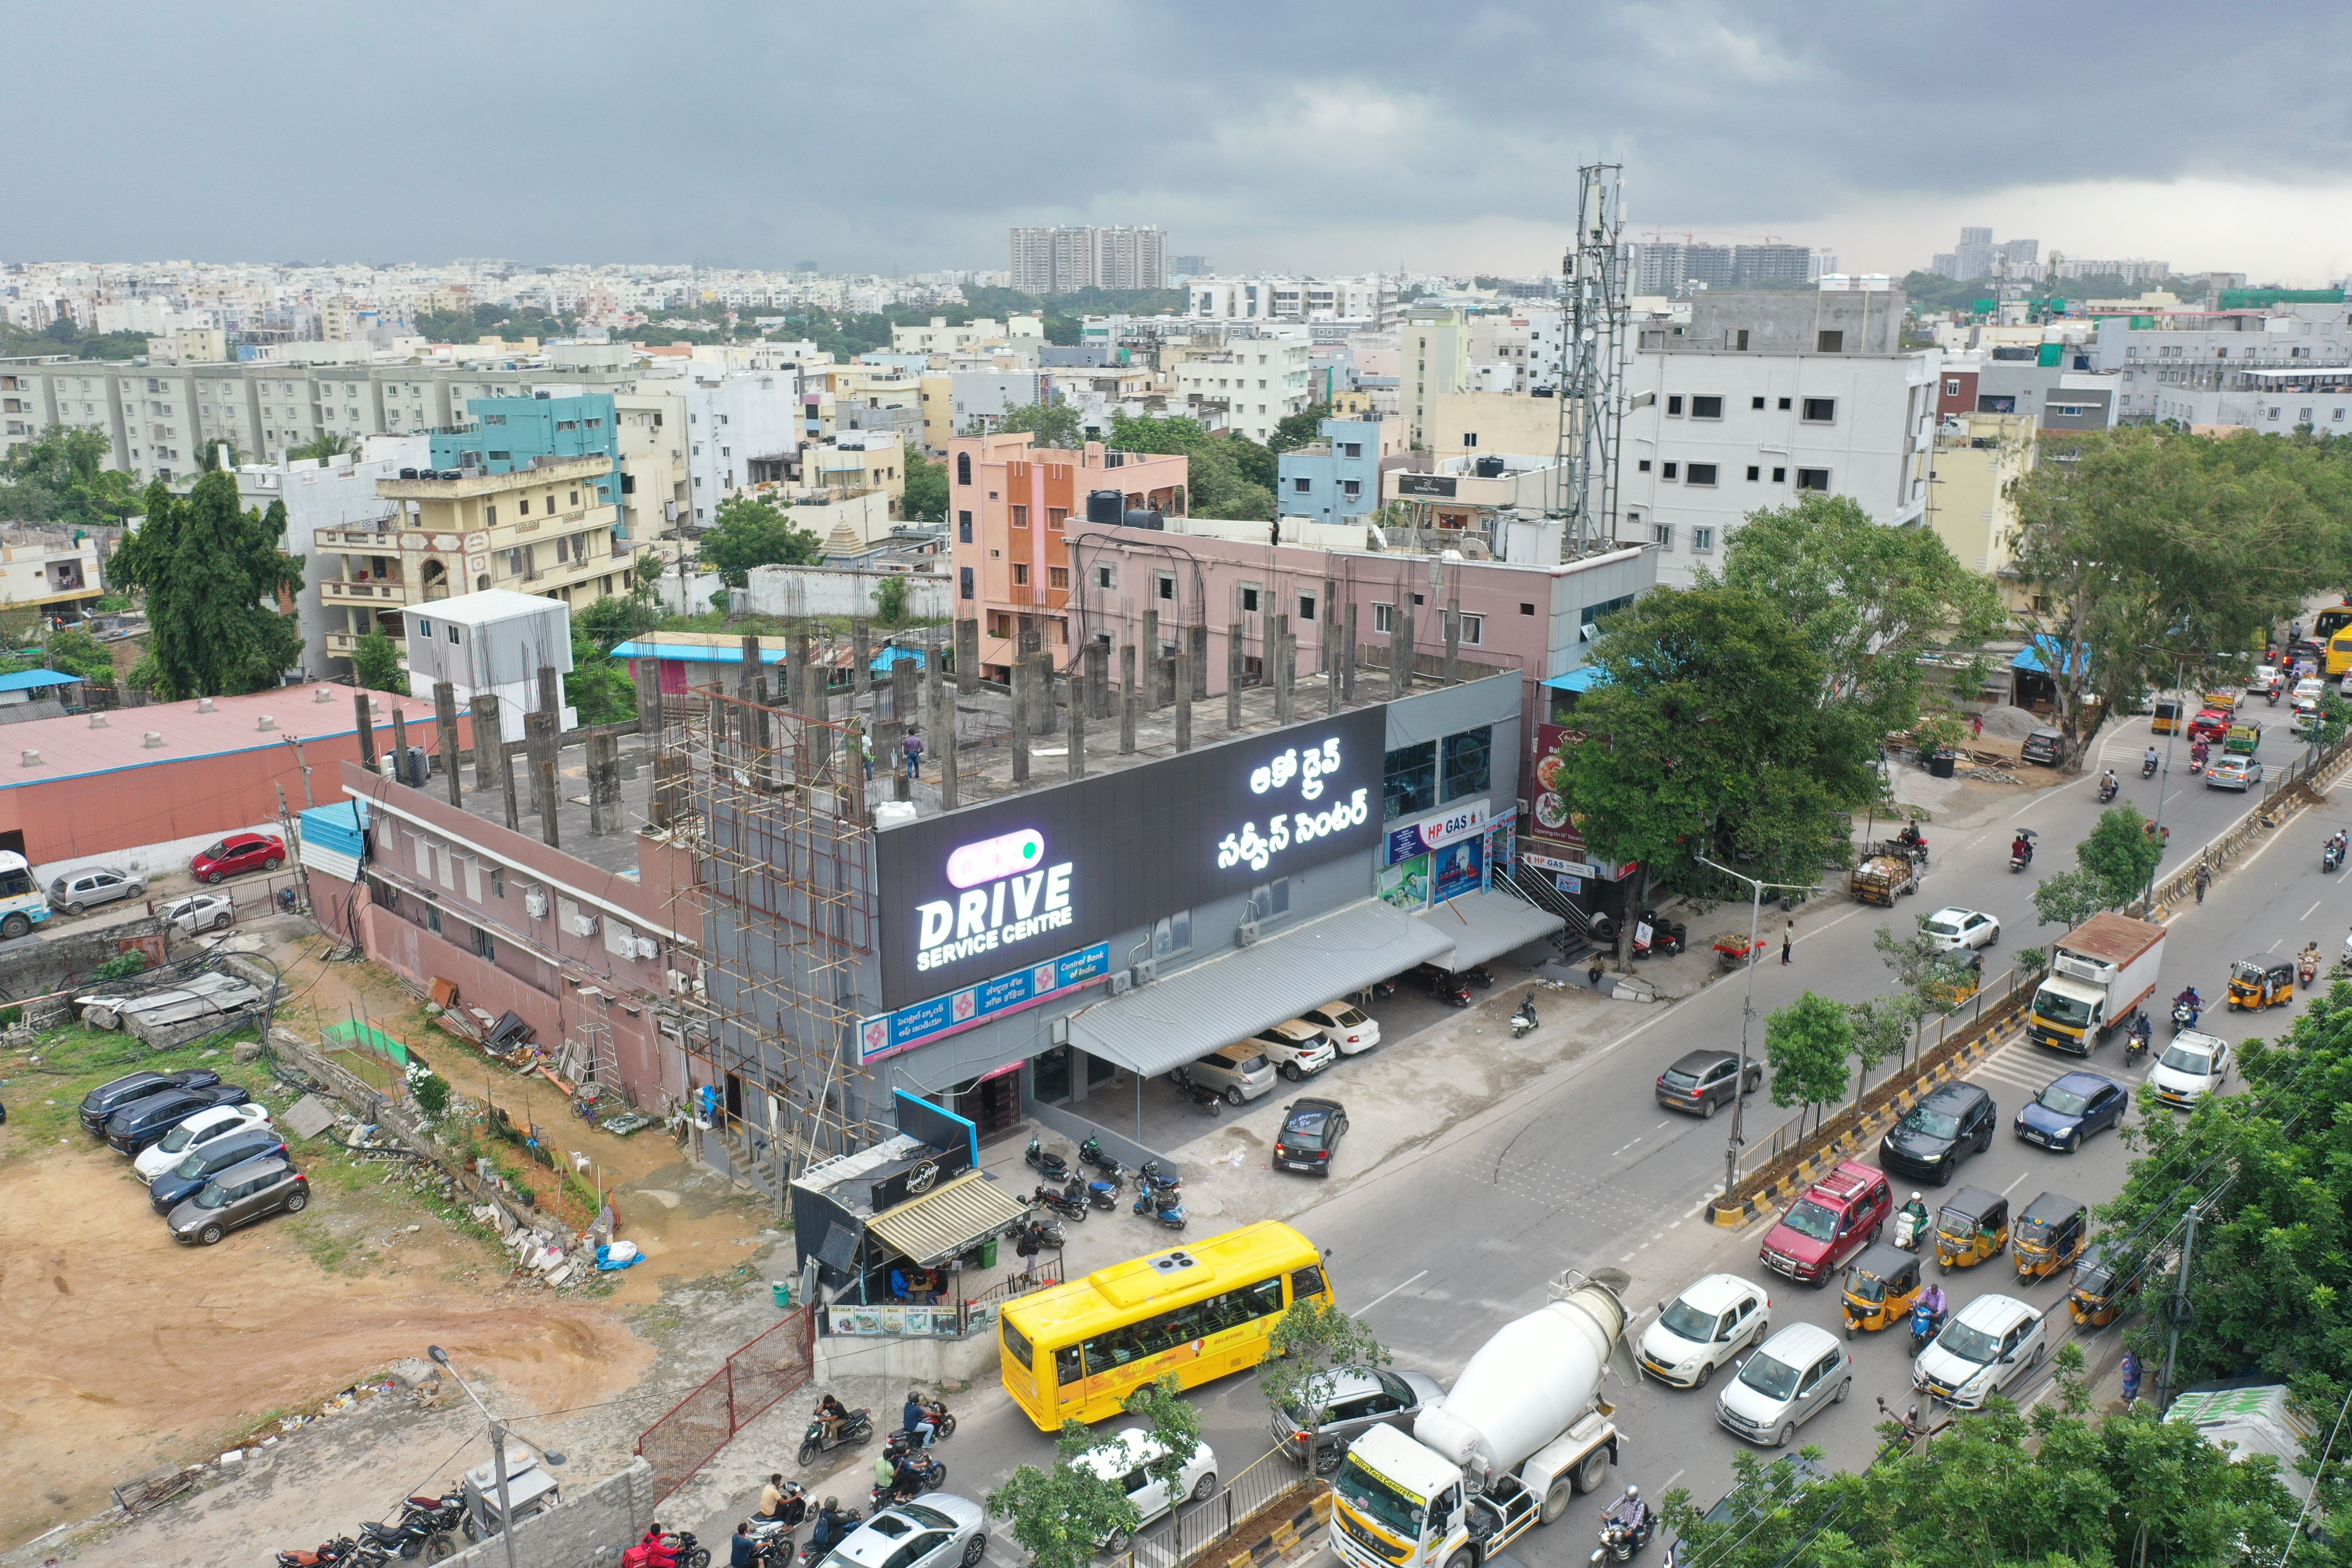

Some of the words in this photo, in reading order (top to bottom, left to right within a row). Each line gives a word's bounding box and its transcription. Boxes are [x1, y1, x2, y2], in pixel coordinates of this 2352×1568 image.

[1302, 738, 1340, 800] డ్రైవ్
[1218, 814, 1289, 870] సర్వీస్
[1295, 788, 1367, 843] సెంటర్
[1428, 823, 1442, 840] HP
[1446, 815, 1467, 834] GAS
[1534, 828, 1553, 837] Opening
[1547, 860, 1564, 868] GAS
[915, 862, 1072, 950] DRIVE
[1412, 903, 1425, 912] AGENCY
[917, 930, 998, 971] SERVICE
[1002, 906, 1072, 943] CENTRE
[1061, 959, 1086, 972] Central
[1087, 950, 1104, 962] Bank
[1070, 968, 1078, 979] of
[1079, 965, 1096, 976] India
[906, 1174, 923, 1190] Street
[941, 1249, 957, 1259] The
[959, 1234, 986, 1251] Street
[988, 1221, 1014, 1237] Kettle
[1214, 1331, 1244, 1344] BELIEVING
[1155, 1354, 1177, 1366] SEEING
[1354, 1457, 1383, 1482] UltraTech
[1383, 1478, 1415, 1499] Concrete
[1353, 1527, 1385, 1554] EICHER
